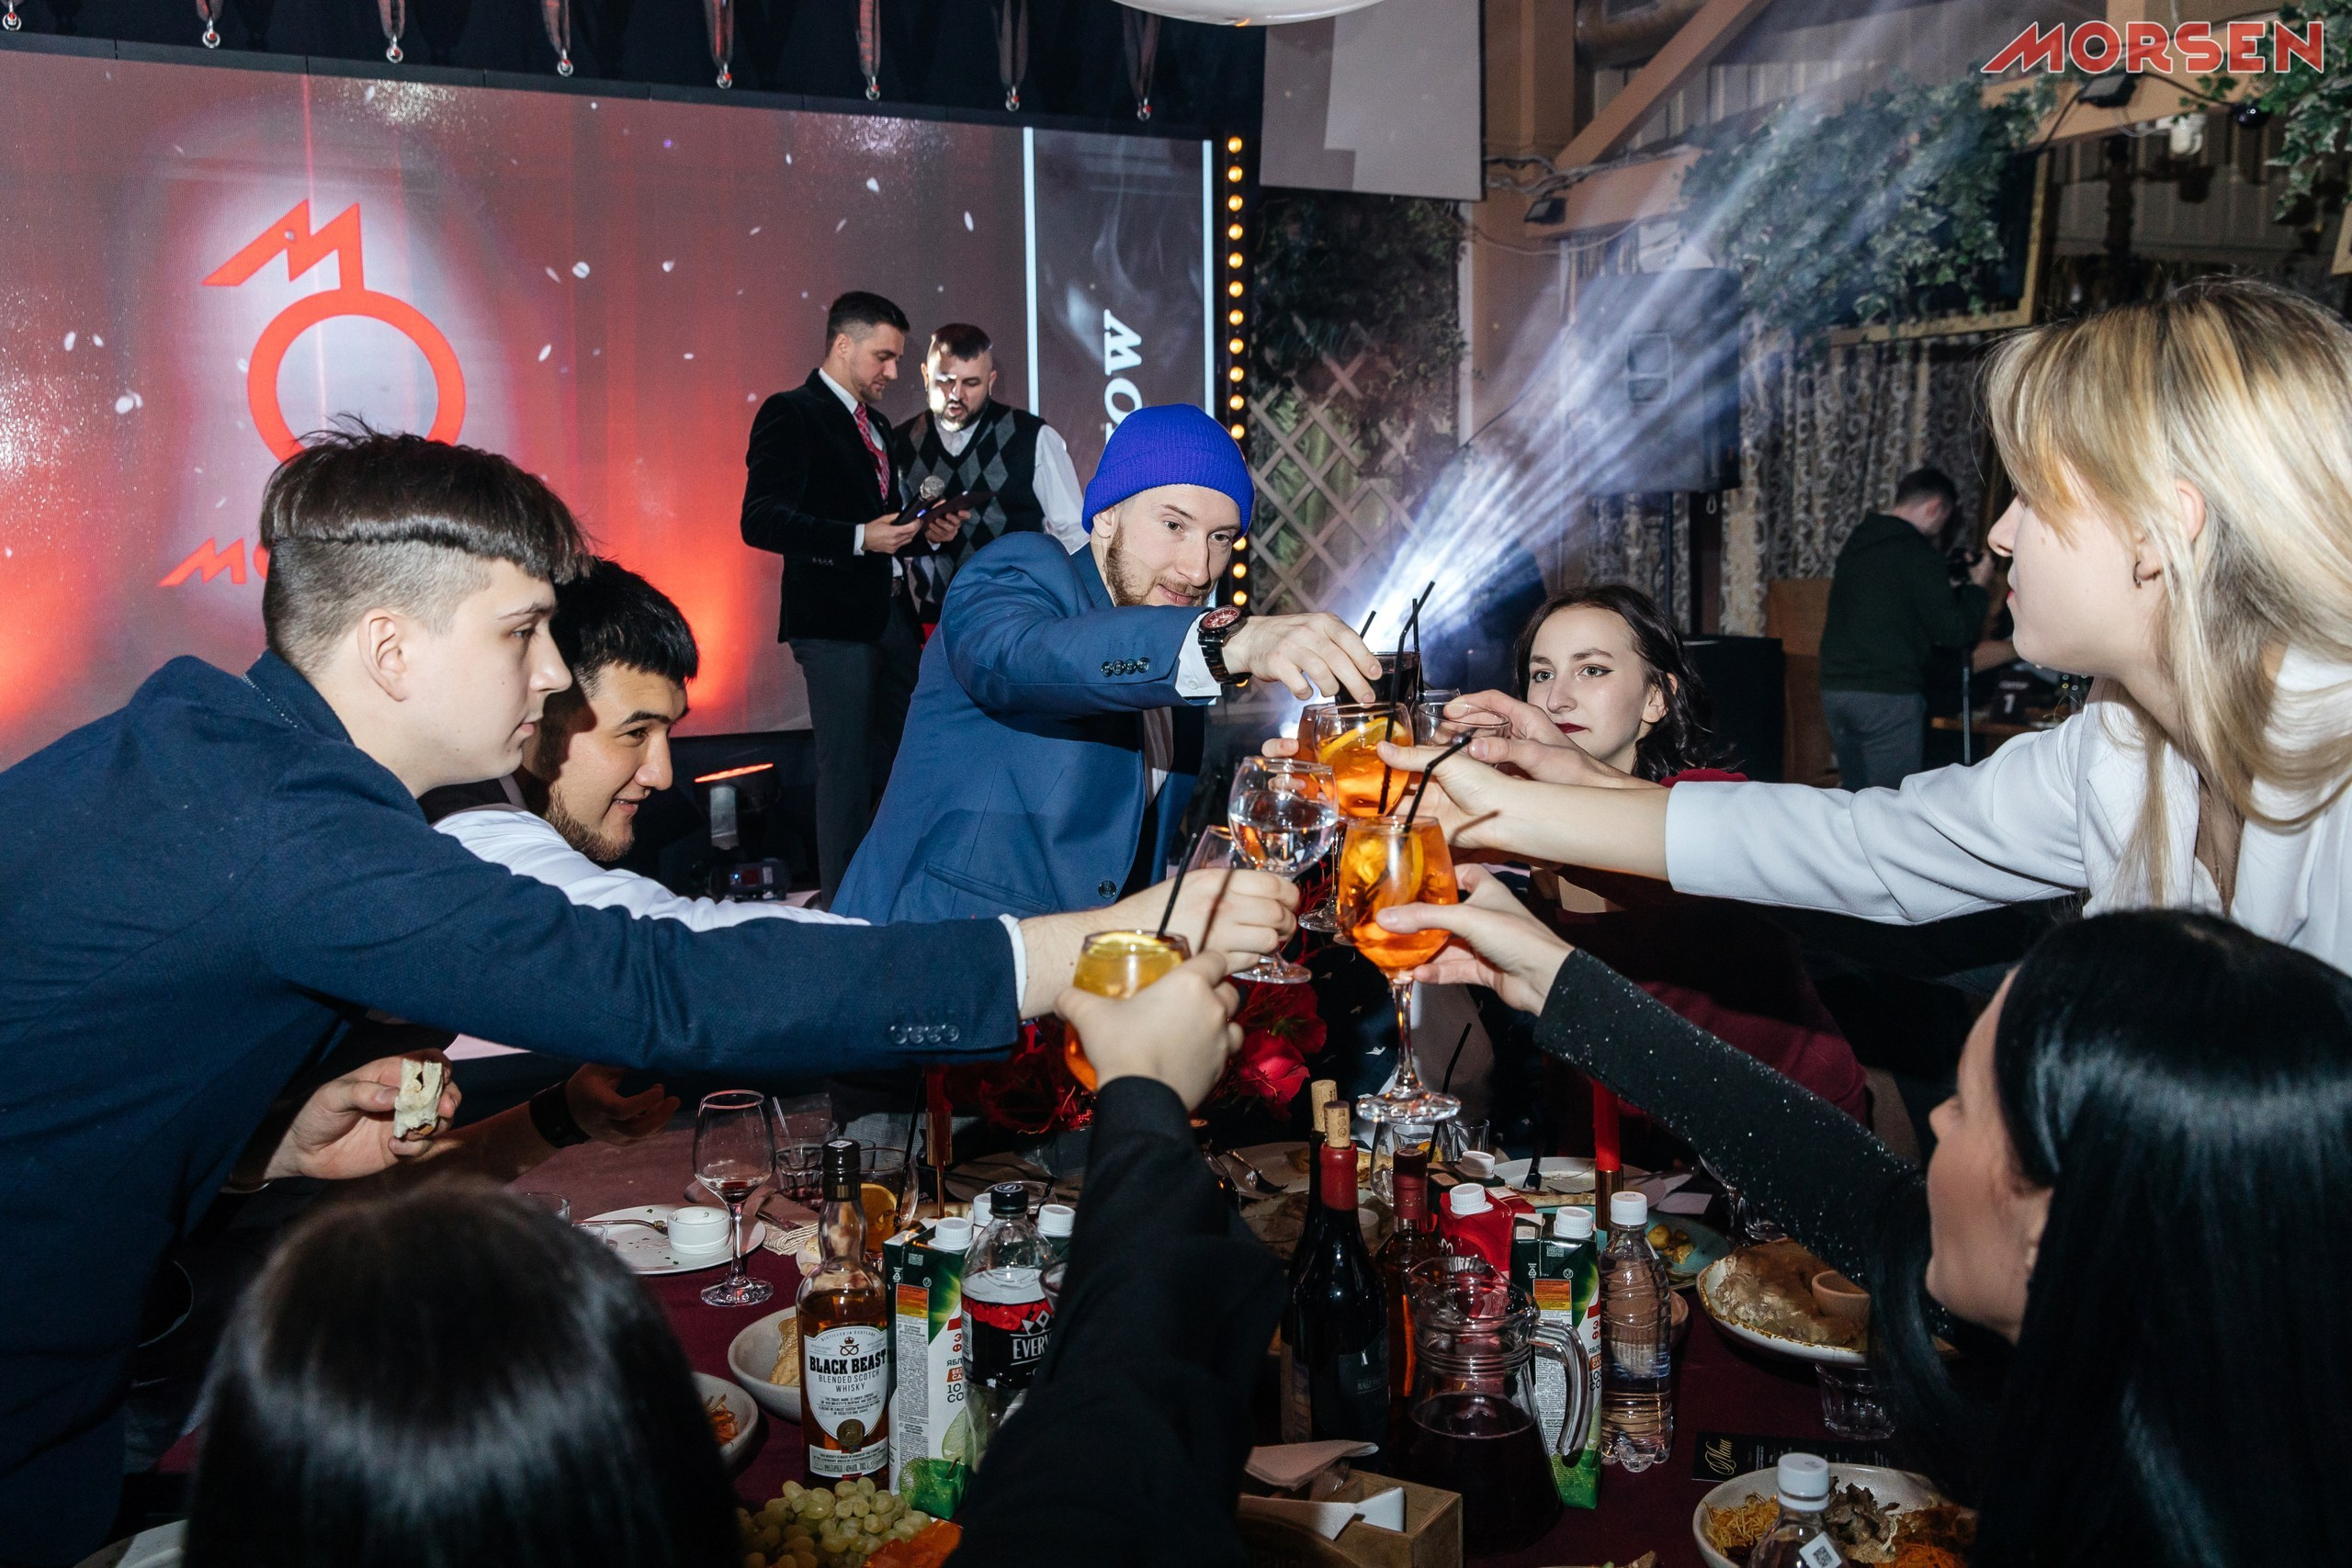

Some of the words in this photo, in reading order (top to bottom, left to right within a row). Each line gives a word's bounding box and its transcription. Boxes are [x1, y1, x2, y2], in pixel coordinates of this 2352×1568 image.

[809, 1355, 848, 1375] BLACK
[852, 1348, 887, 1374] BEAST
[819, 1374, 852, 1384] BLENDED
[854, 1368, 880, 1382] SCOTCH
[835, 1382, 865, 1393] WHISKY
[1704, 1438, 1737, 1476] Menu
